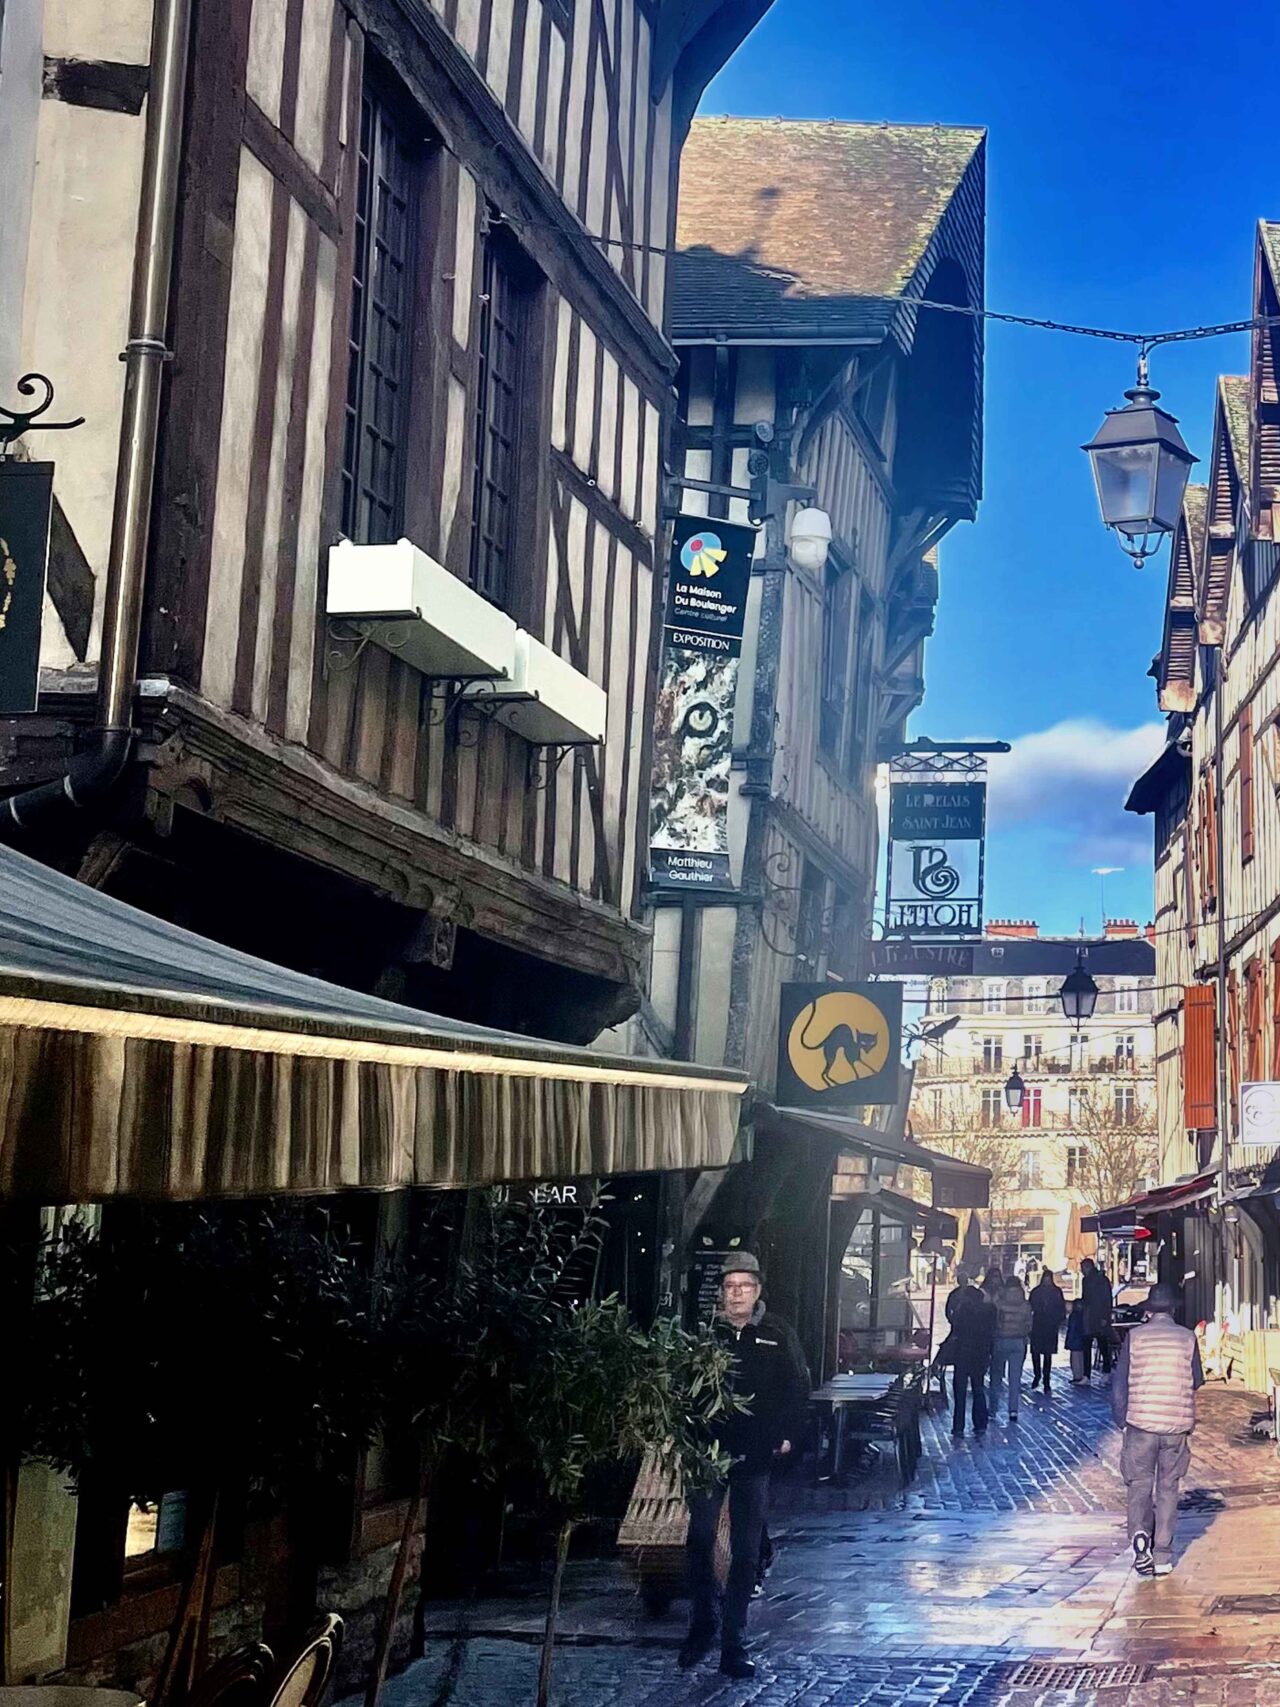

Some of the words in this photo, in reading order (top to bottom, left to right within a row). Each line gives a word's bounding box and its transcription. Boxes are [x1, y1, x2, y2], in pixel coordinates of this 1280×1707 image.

[676, 582, 688, 593] La
[689, 585, 722, 599] Maison
[675, 595, 688, 605] Du
[690, 597, 737, 615] Boulanger
[673, 632, 730, 650] EXPOSITION
[667, 856, 713, 869] Matthieu
[668, 870, 714, 882] Gauthier
